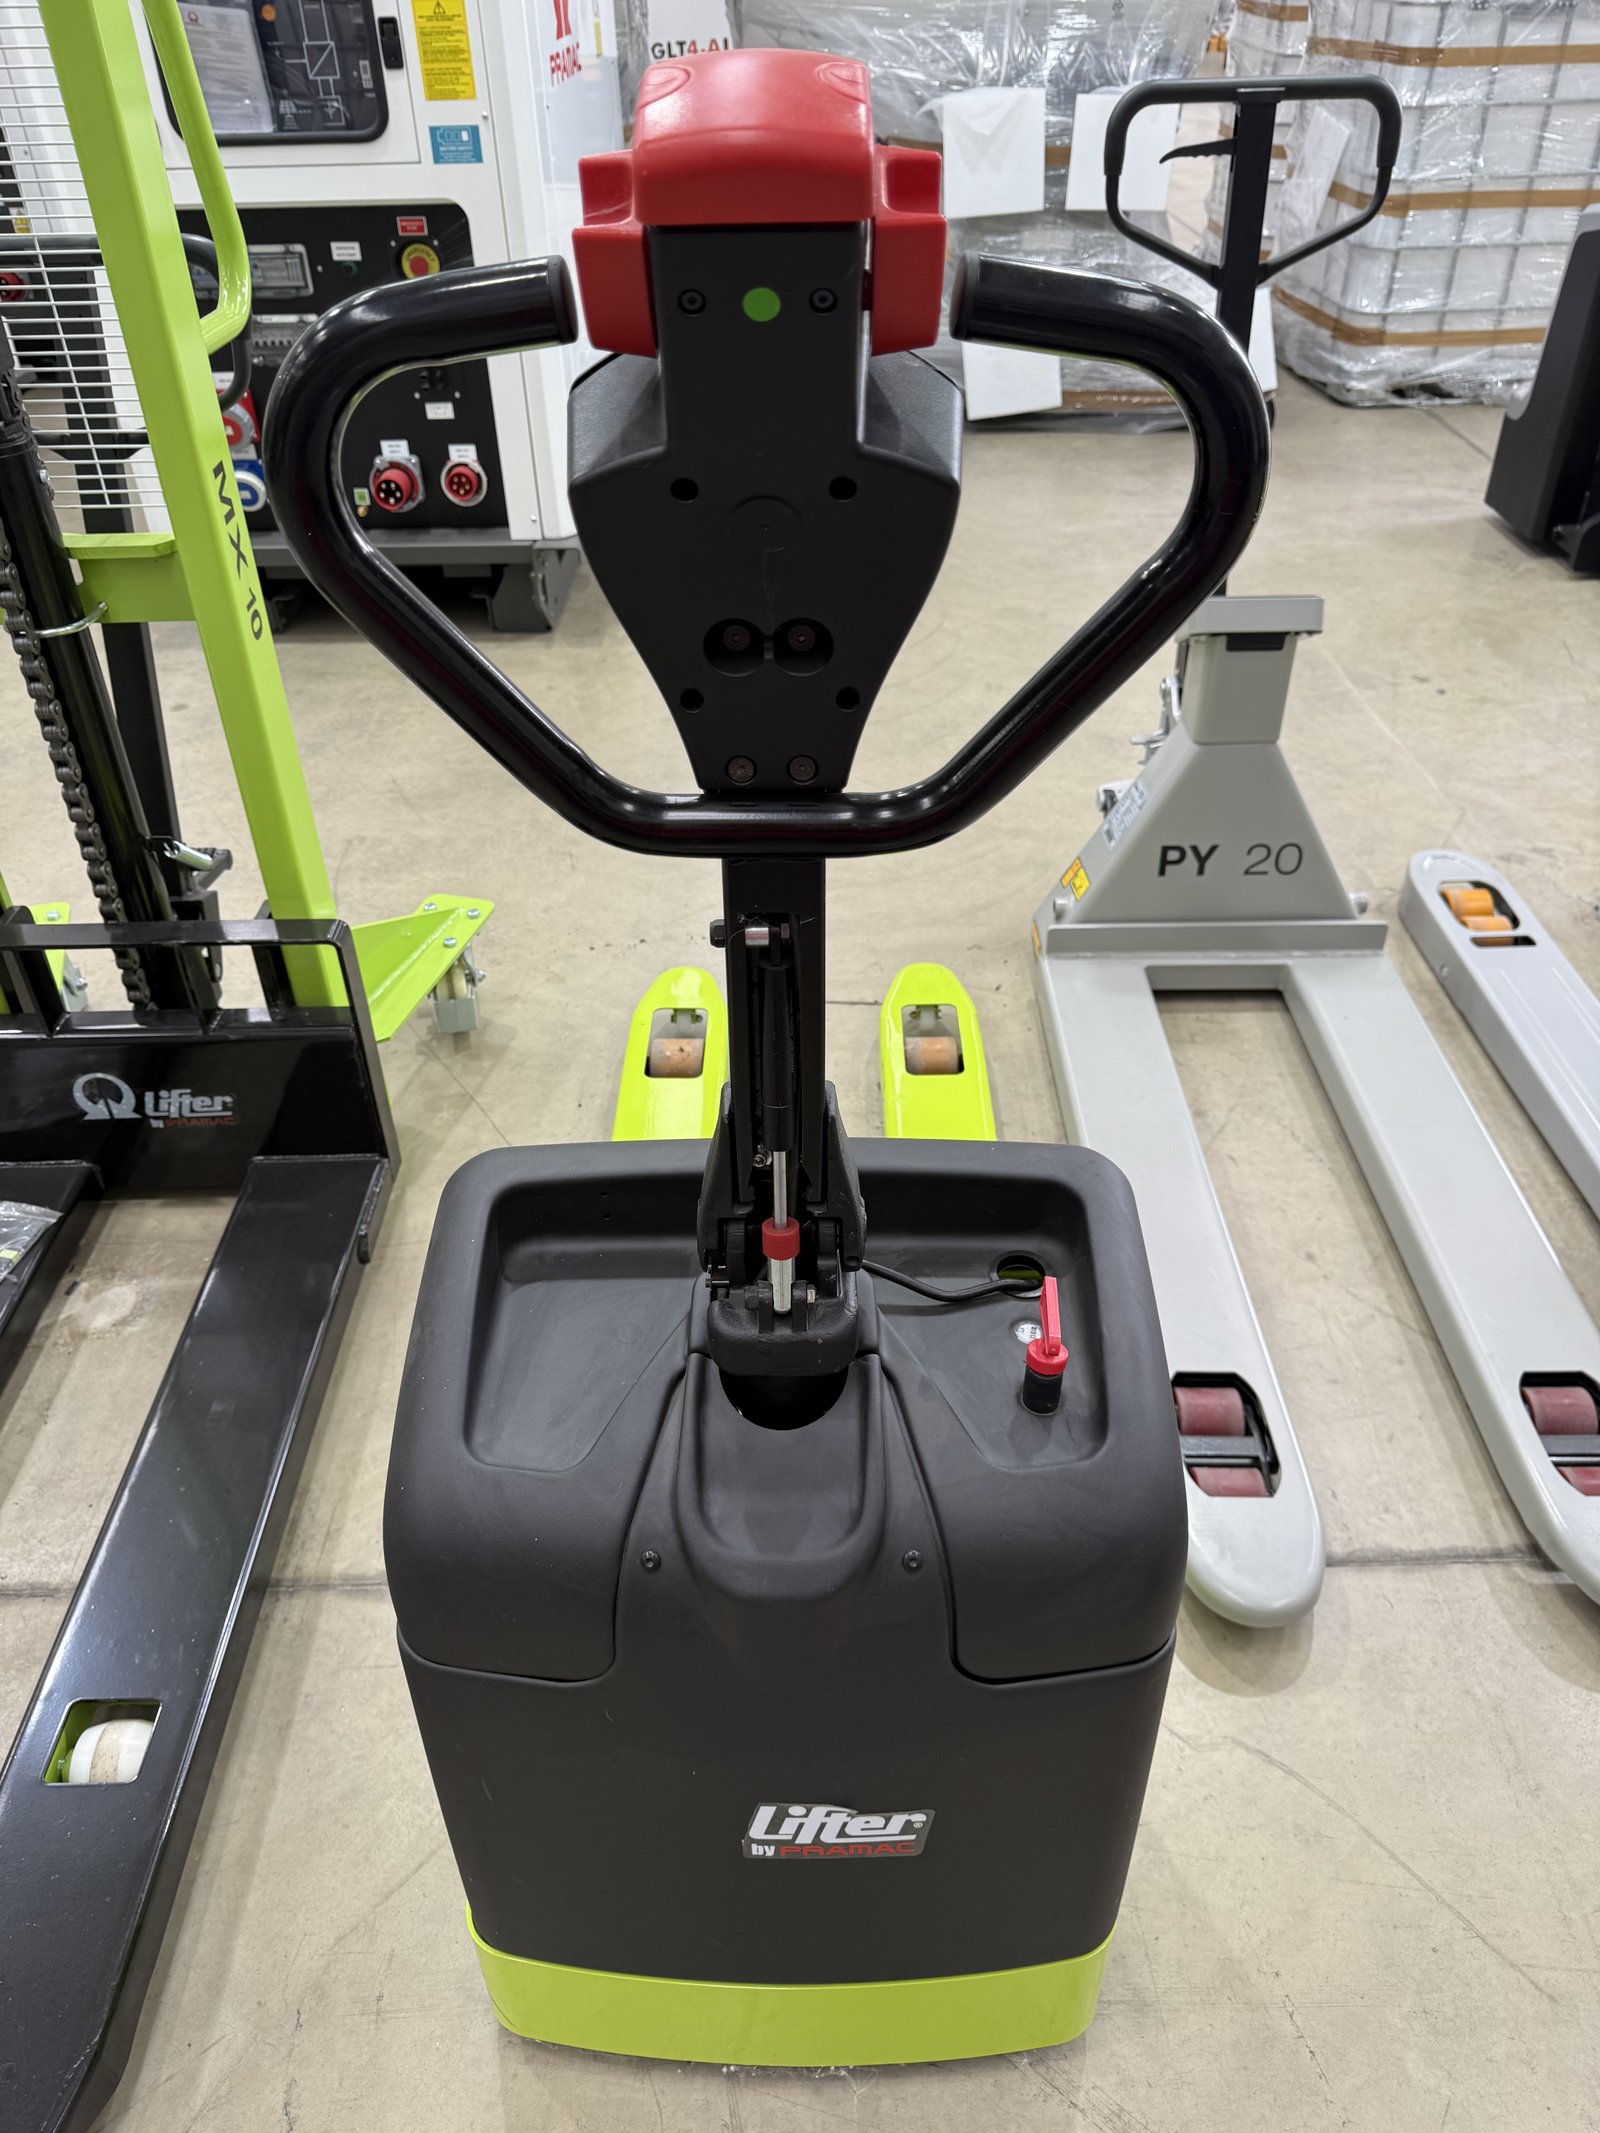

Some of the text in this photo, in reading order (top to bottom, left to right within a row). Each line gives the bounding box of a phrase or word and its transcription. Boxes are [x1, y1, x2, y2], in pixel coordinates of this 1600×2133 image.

[212, 459, 263, 641] MX 10
[1157, 842, 1304, 877] PY 20
[144, 1089, 234, 1118] Lifter
[751, 1842, 918, 1857] by PRAMAC
